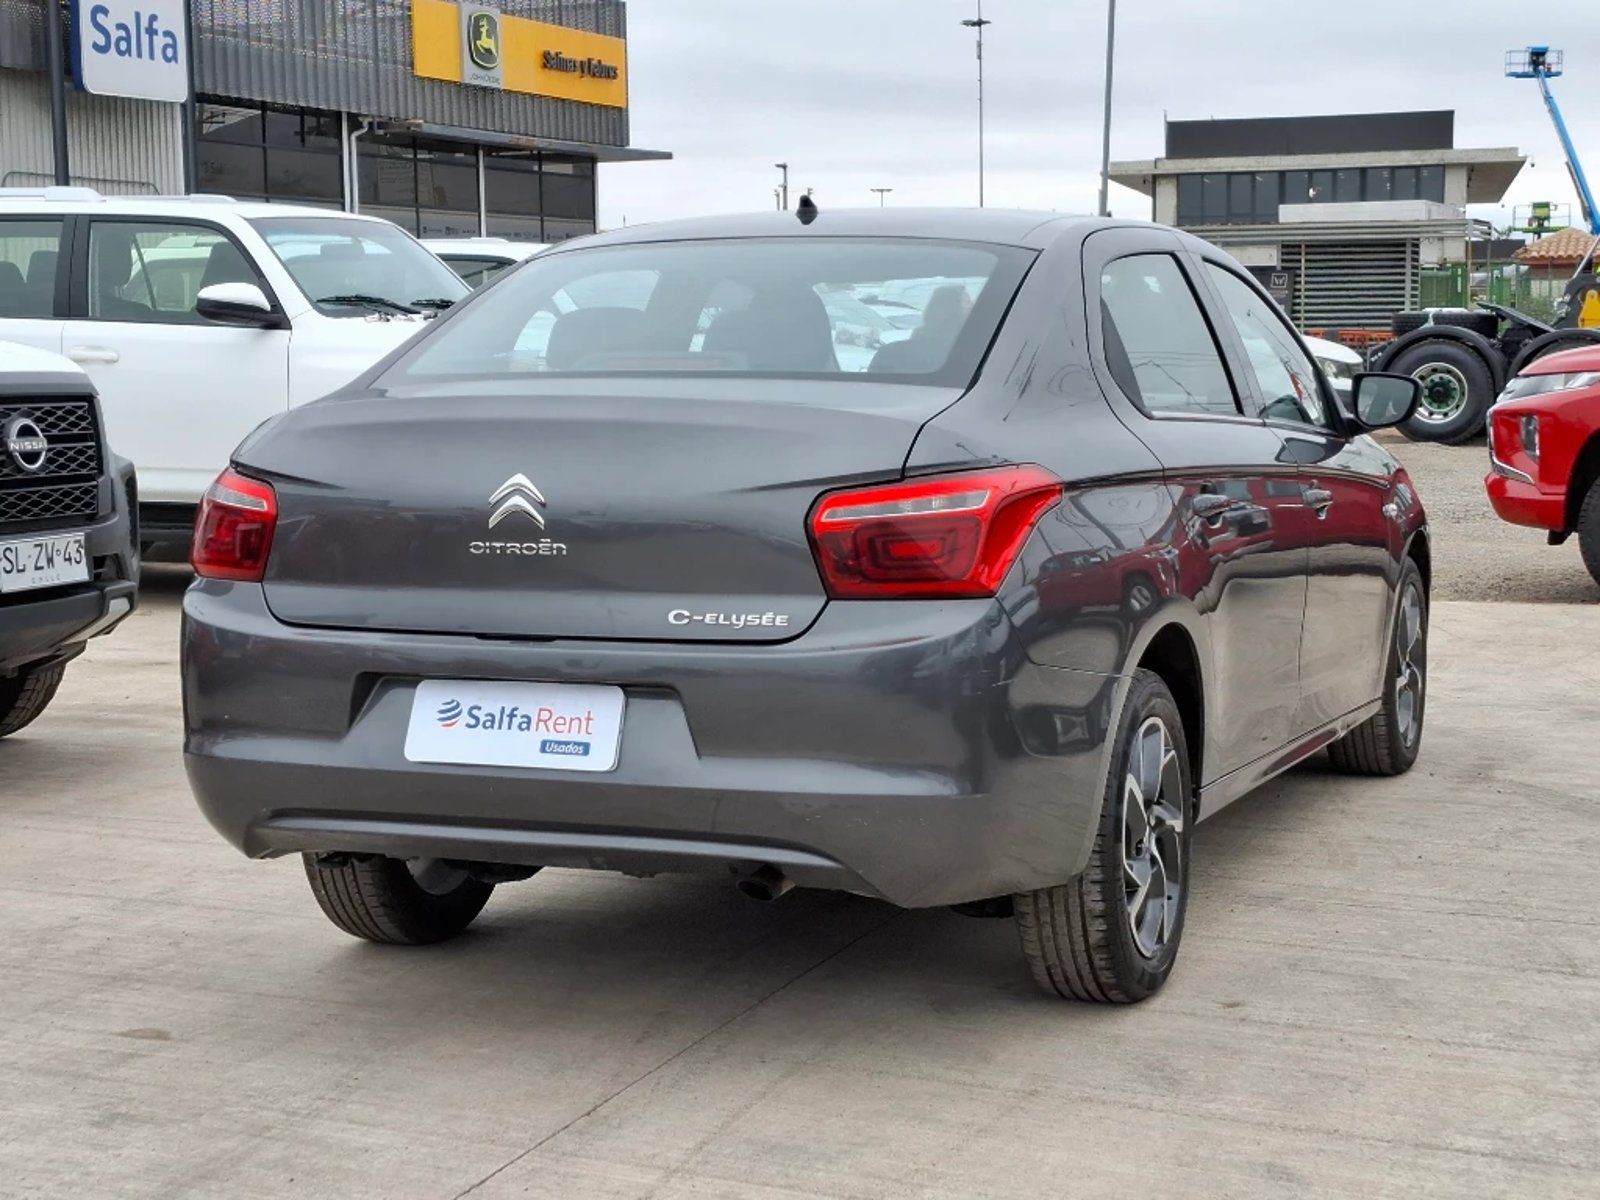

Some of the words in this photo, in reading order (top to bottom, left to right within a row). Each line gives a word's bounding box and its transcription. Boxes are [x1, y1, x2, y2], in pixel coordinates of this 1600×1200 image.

[90, 4, 179, 64] Salfa
[667, 608, 790, 629] C-ELYSÉE
[544, 741, 584, 755] Usados
